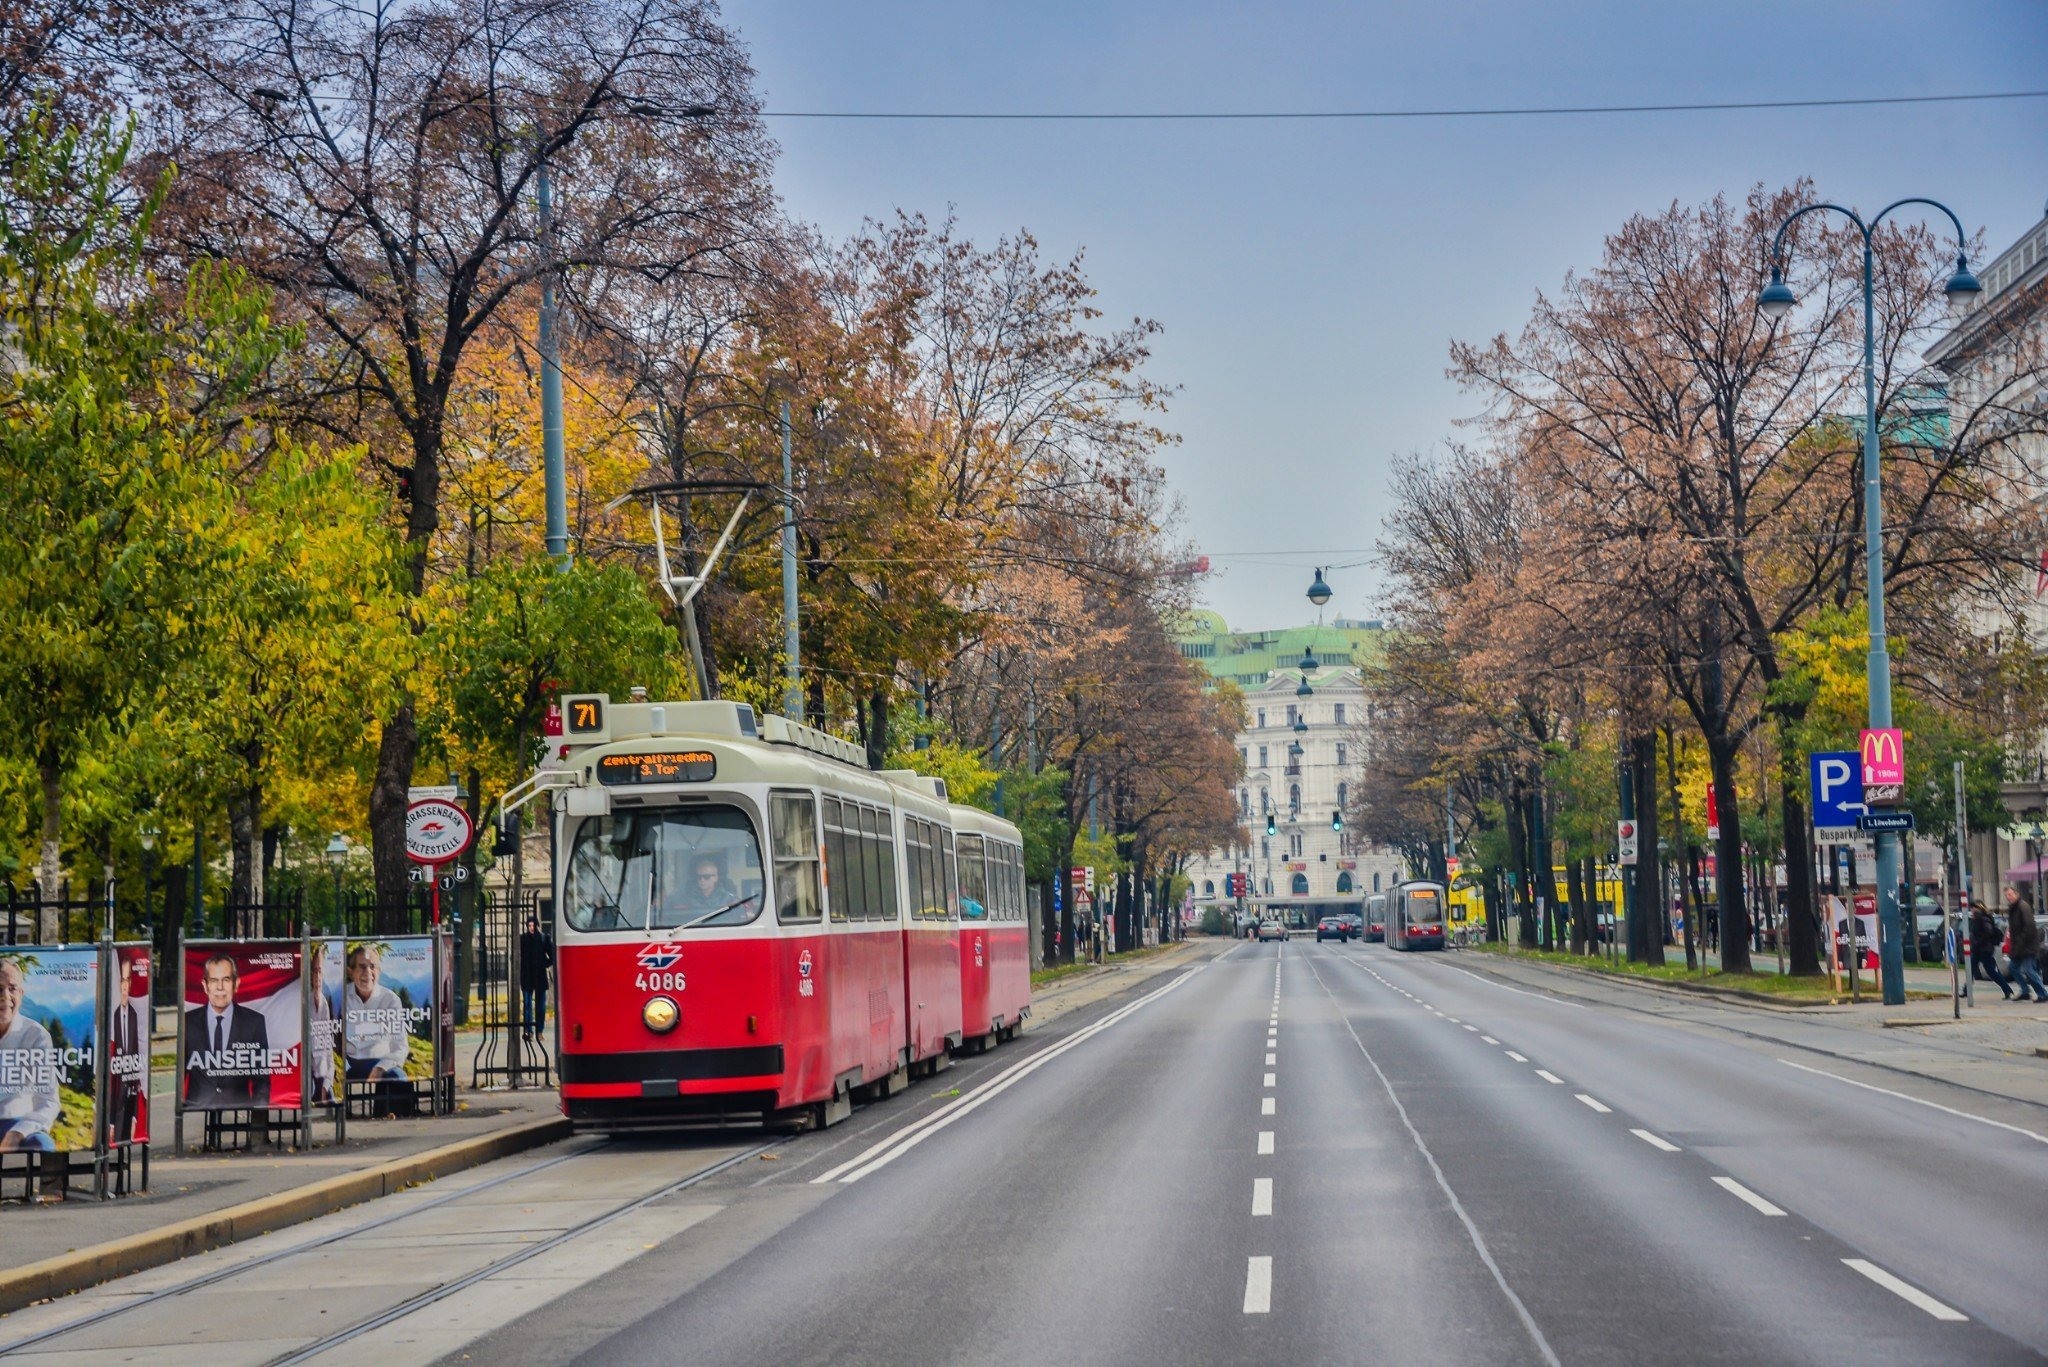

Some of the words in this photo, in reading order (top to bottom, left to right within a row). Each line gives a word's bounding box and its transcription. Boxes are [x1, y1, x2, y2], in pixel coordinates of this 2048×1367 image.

[574, 703, 596, 727] 71
[654, 763, 680, 775] Tor
[1820, 759, 1851, 802] P
[1820, 828, 1866, 842] Busparkpla
[635, 972, 686, 992] 4086
[346, 1007, 431, 1023] STERREICH
[0, 1048, 92, 1067] ERREICH
[186, 1048, 298, 1070] ANSEHEN
